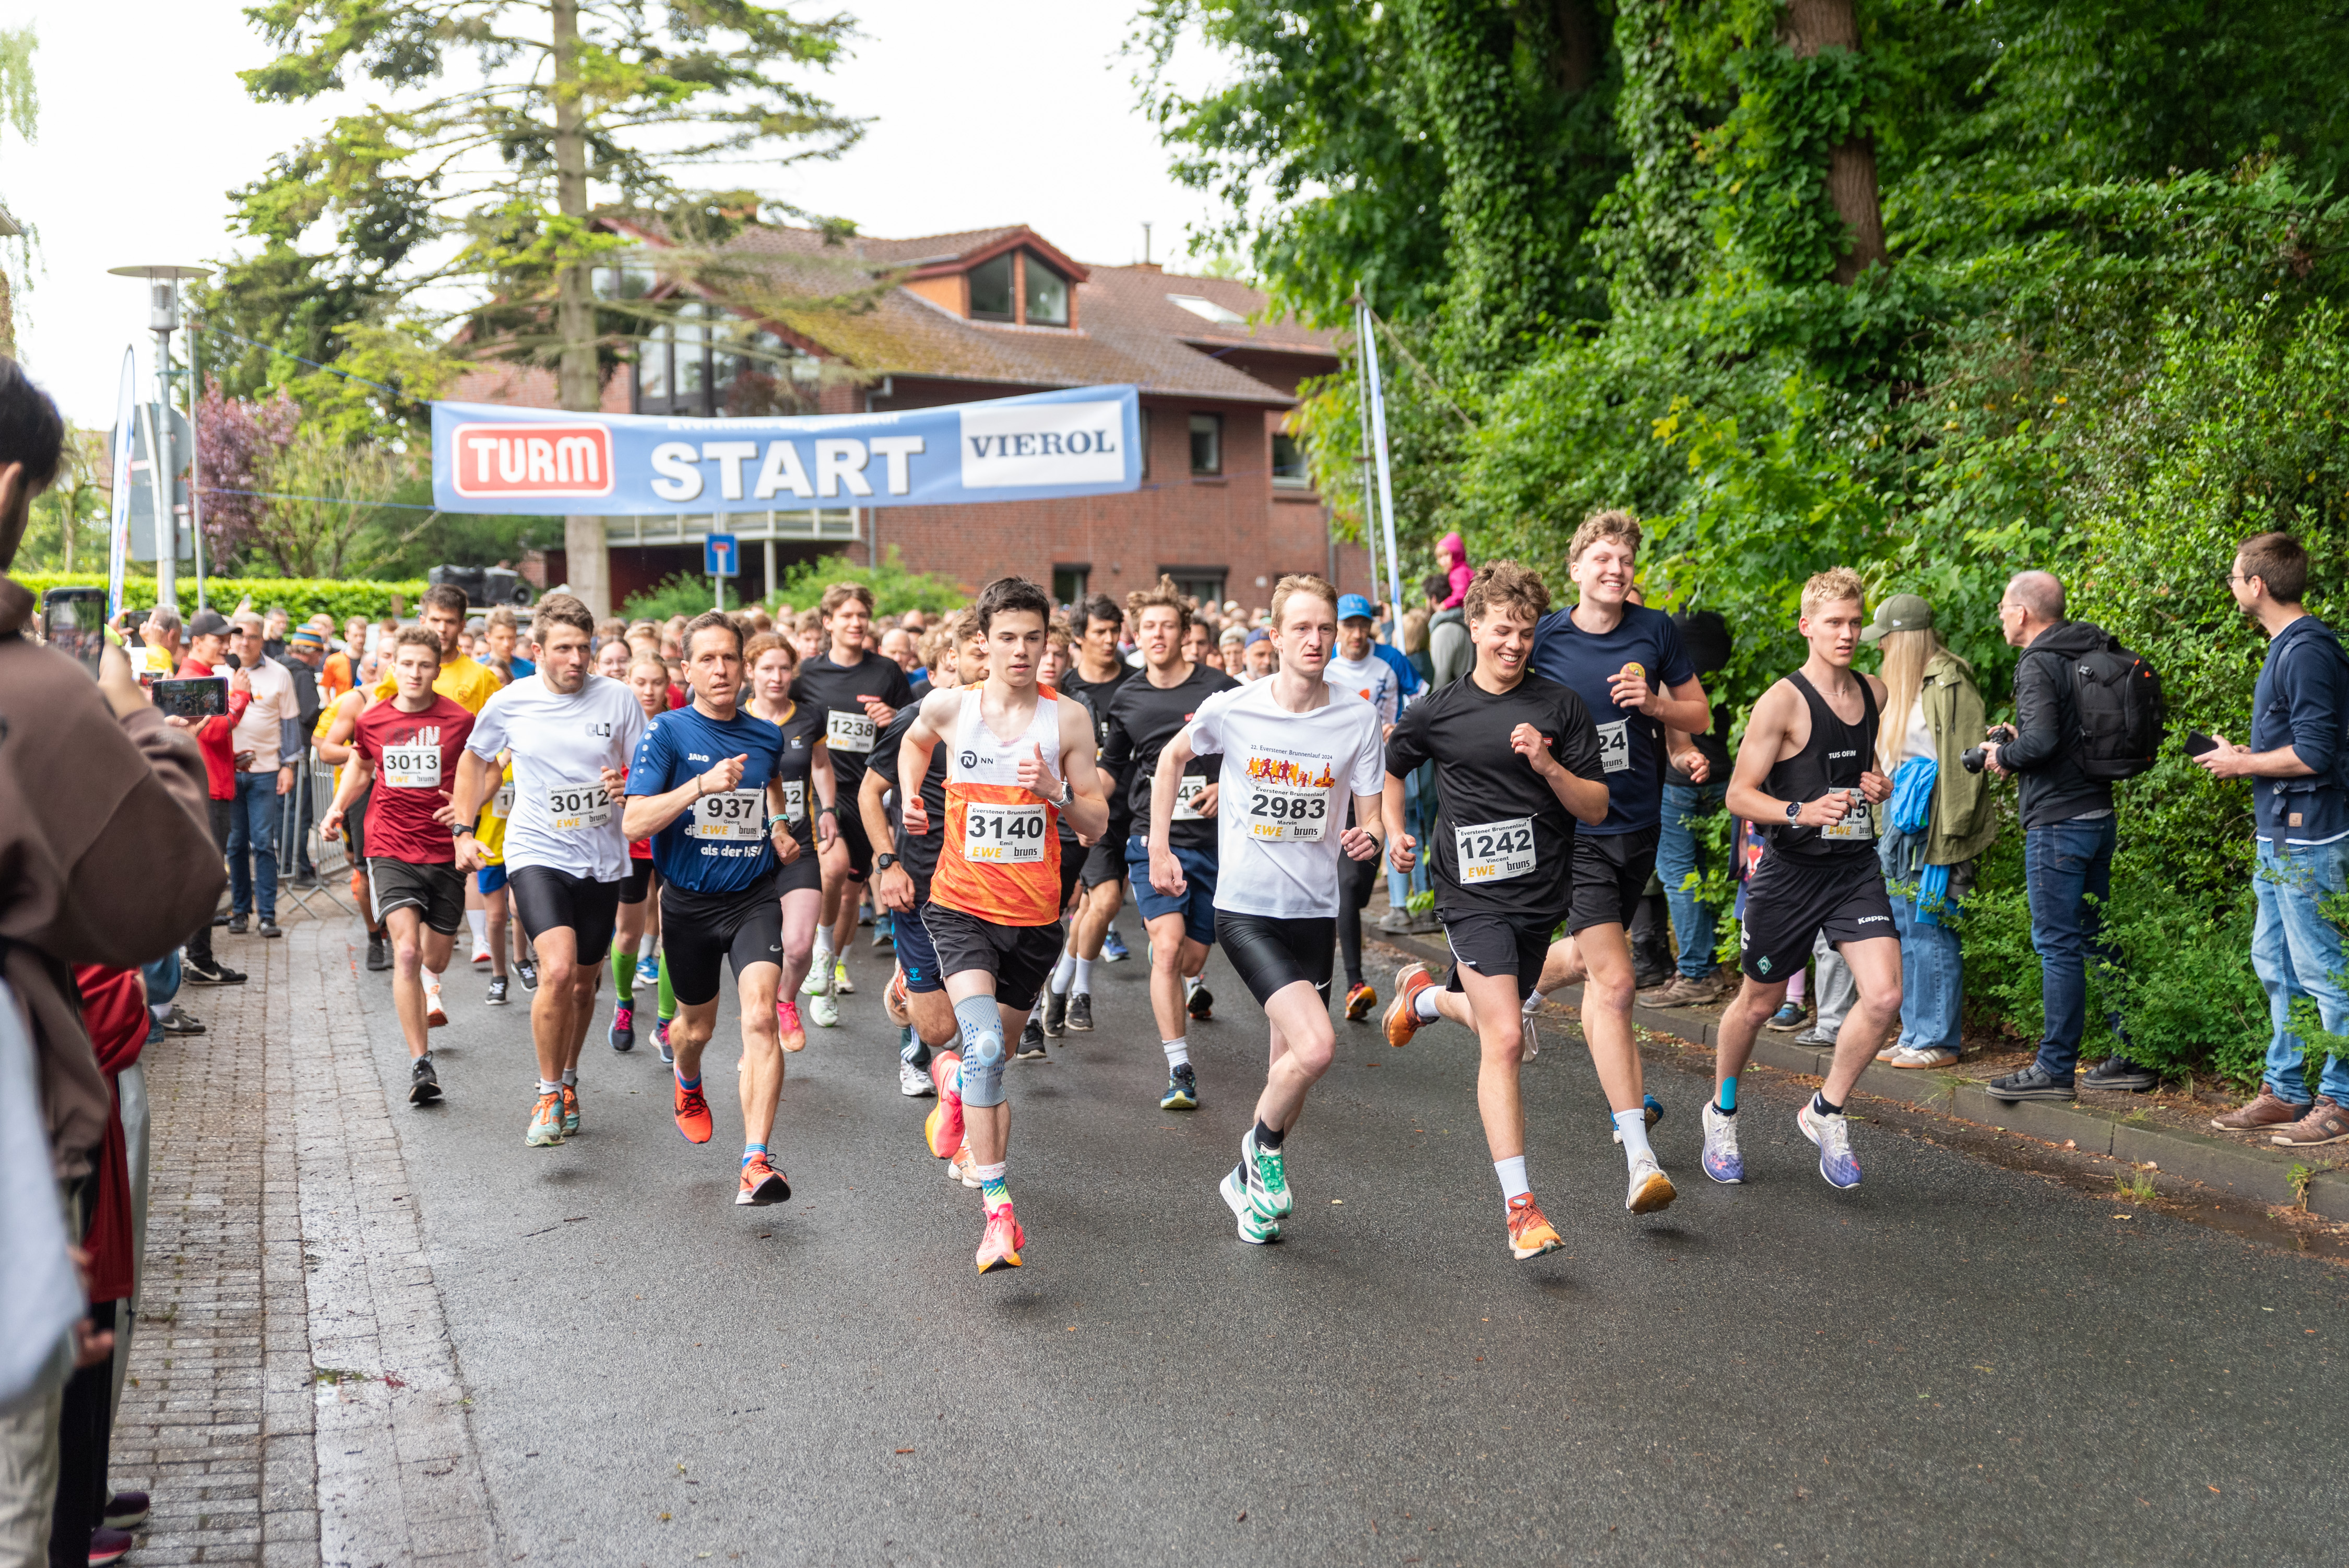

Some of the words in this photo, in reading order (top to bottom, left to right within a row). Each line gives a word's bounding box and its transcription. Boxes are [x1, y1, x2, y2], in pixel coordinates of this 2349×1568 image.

[969, 430, 1114, 458] VIEROL
[468, 436, 600, 483] TURM
[650, 436, 925, 502] START
[831, 719, 874, 737] 1238
[687, 753, 710, 762] JAKO
[1260, 745, 1288, 754] Everstener
[1289, 750, 1321, 759] Brunnenlauf
[386, 755, 437, 769] 3013
[1256, 787, 1288, 795] Everstener
[550, 789, 609, 813] 3012
[707, 798, 755, 818] 937
[1250, 794, 1325, 819] 2983
[556, 817, 580, 828] EWE
[589, 813, 607, 822] bruns
[968, 815, 1043, 839] 3140
[1492, 822, 1527, 832] Brunnenlauf
[702, 825, 729, 835] EWE
[739, 826, 757, 834] bruns
[1254, 824, 1283, 837] EWE
[1294, 826, 1318, 836] bruns
[1828, 825, 1852, 835] EWE
[701, 844, 719, 856] als
[720, 845, 743, 857] der
[1460, 829, 1532, 859] 1242
[972, 847, 1003, 858] EWE
[1014, 847, 1038, 857] bruns
[1468, 865, 1496, 878] EWE
[1506, 860, 1530, 871] bruns
[1858, 915, 1890, 925] Kappa
